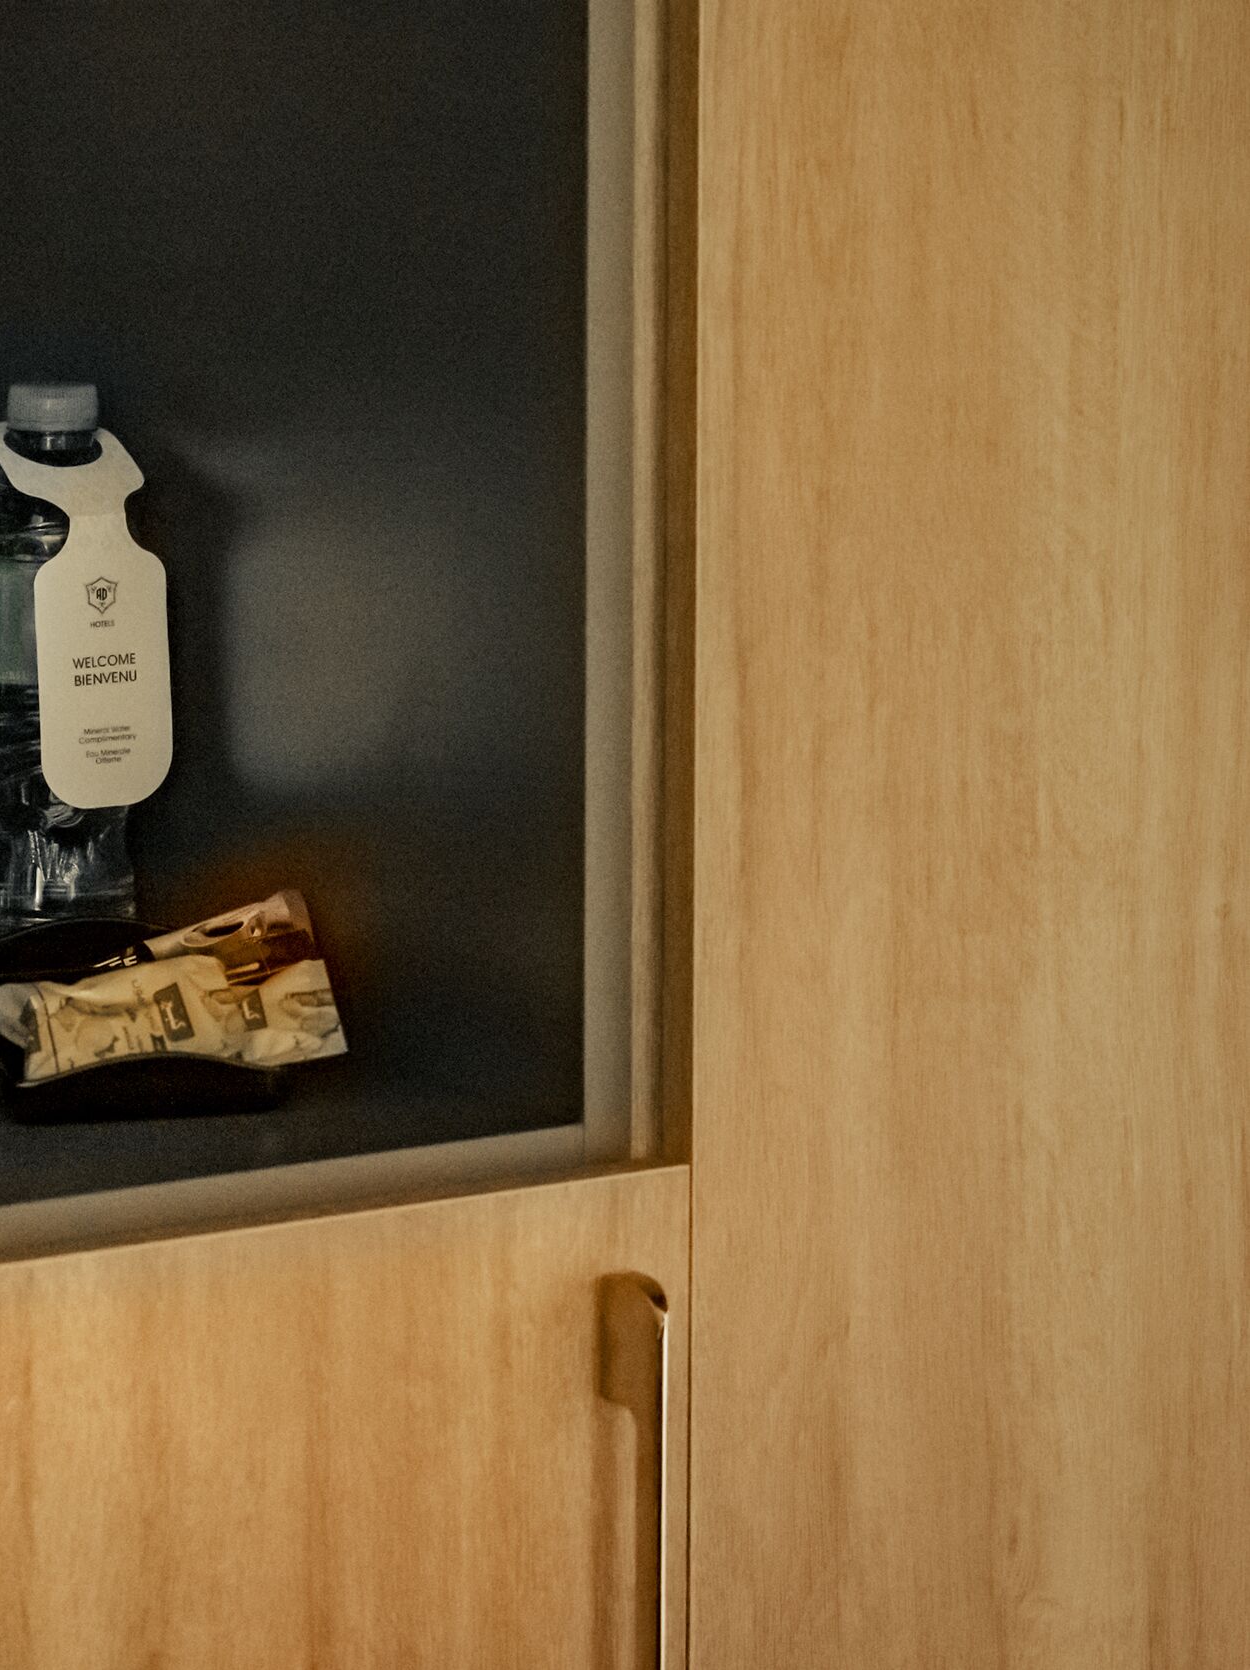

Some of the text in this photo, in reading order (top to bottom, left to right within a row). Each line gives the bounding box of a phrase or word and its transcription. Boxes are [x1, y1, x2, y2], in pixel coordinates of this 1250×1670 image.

[90, 620, 115, 628] HOTELS
[72, 653, 136, 669] WELCOME
[74, 670, 138, 687] BIENVENU
[78, 734, 137, 744] Complimentary
